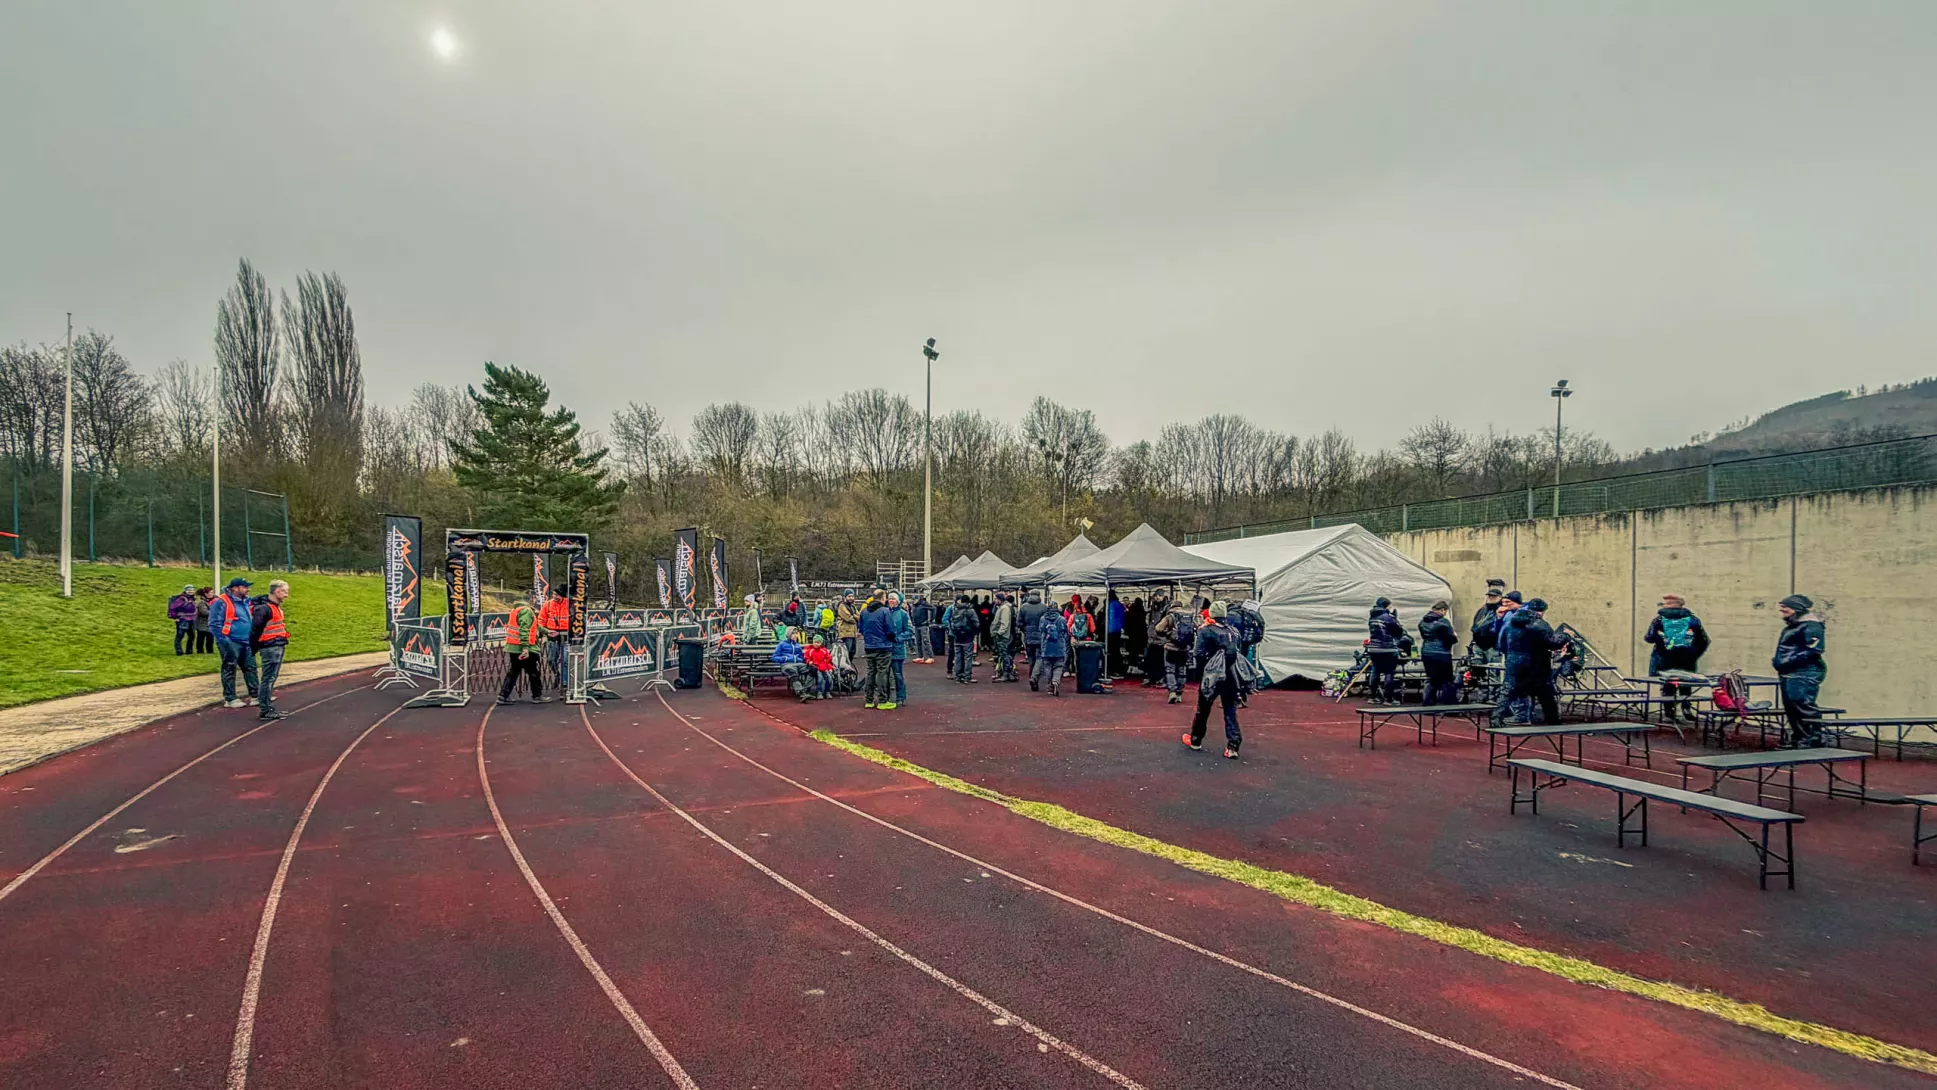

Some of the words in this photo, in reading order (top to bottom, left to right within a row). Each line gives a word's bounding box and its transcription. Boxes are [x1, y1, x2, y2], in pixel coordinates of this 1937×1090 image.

[486, 537, 550, 549] Startkanal
[450, 564, 465, 635] Startkanal
[572, 567, 586, 636] Startkanal
[597, 651, 652, 668] Harzmarsch
